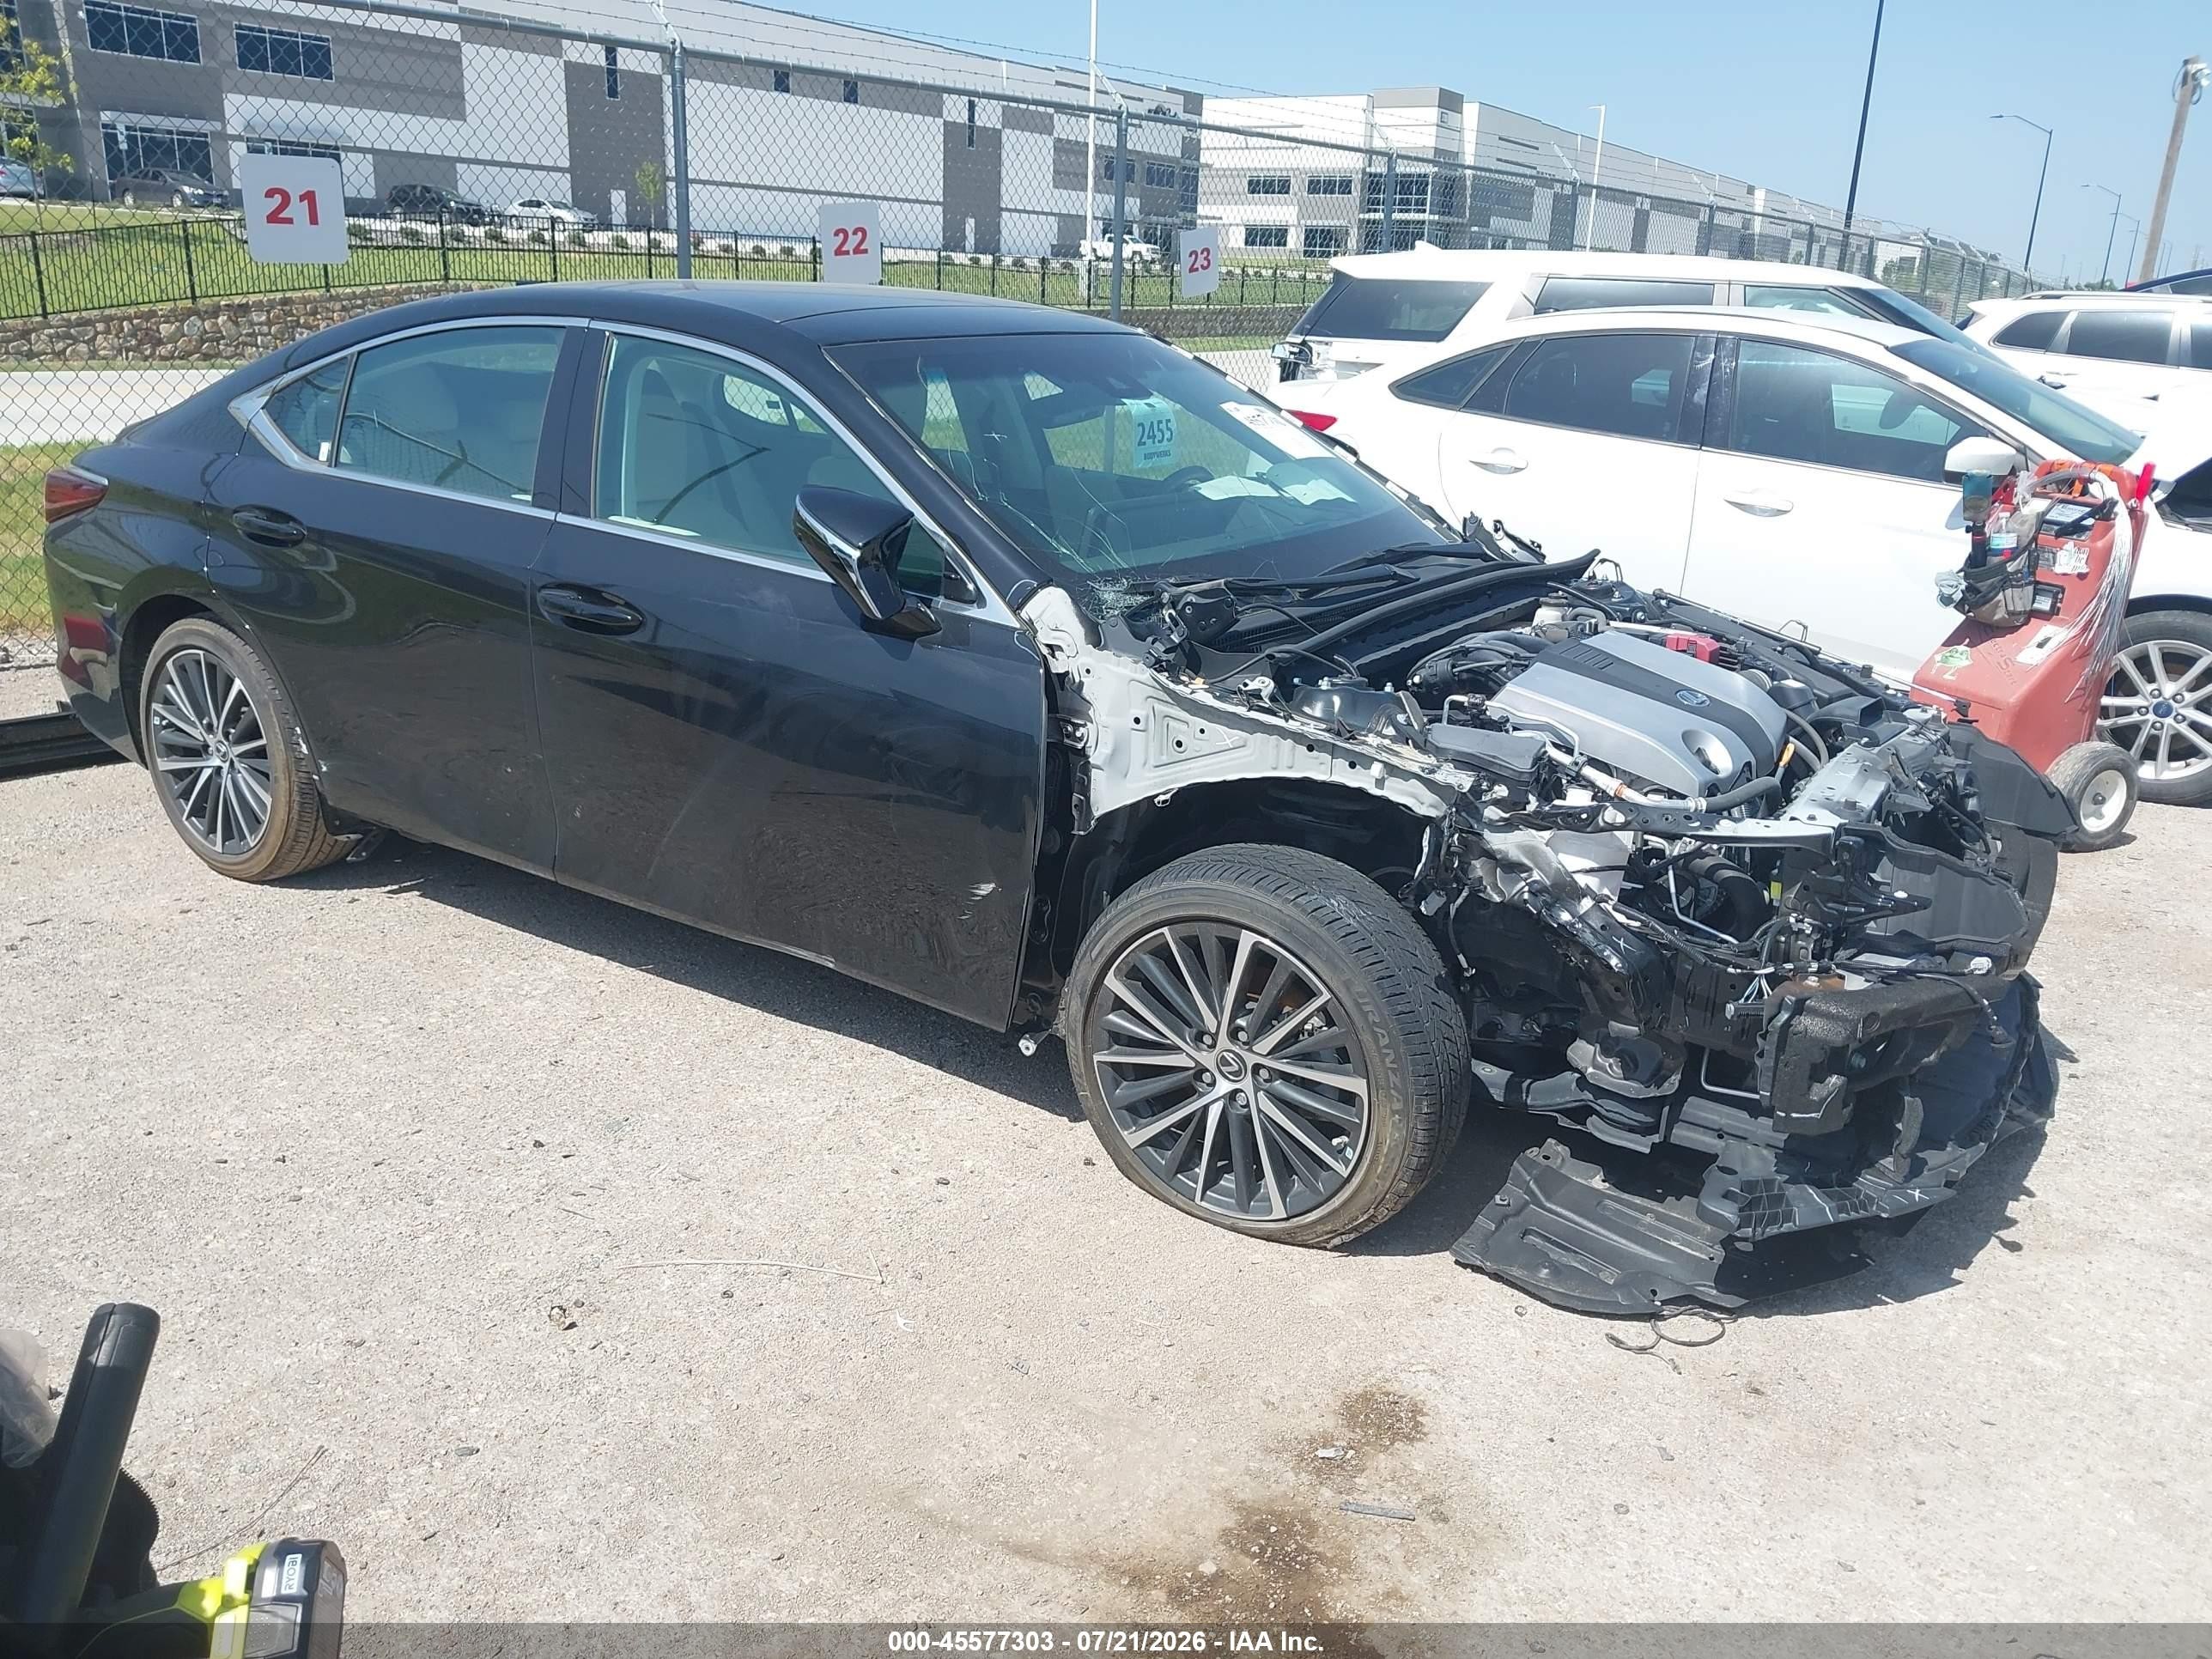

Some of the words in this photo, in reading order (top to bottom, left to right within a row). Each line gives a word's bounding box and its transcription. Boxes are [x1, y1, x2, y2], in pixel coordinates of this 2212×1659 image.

[264, 187, 319, 226] 21
[833, 227, 869, 256] 22
[1188, 247, 1212, 274] 23
[1137, 418, 1174, 447] 2455
[283, 1555, 299, 1592] RYOBI
